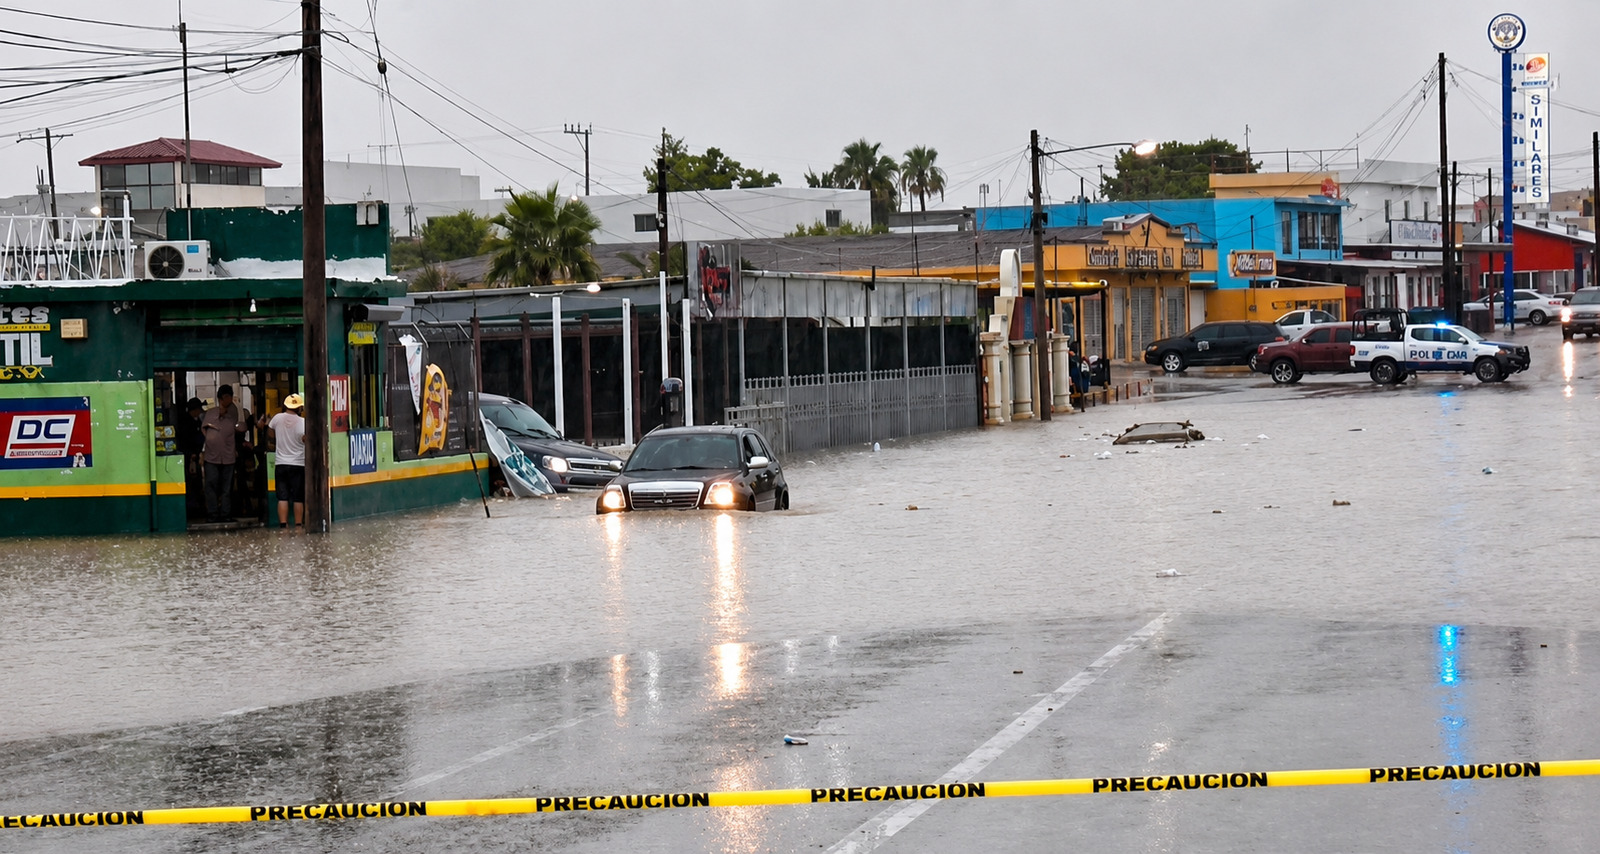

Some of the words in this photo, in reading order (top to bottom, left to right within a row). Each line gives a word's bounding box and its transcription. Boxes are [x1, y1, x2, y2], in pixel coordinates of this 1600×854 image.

[1530, 94, 1543, 199] SIMILARES
[0, 332, 53, 367] TIL
[16, 418, 70, 440] DC
[350, 433, 374, 466] DIARIO
[0, 811, 144, 829] ECAUCION
[250, 802, 427, 821] PRECAUCION
[536, 793, 709, 812] PRECAUCION
[1093, 772, 1268, 793] PRECAUCION
[1371, 762, 1541, 783] PRECAUCION
